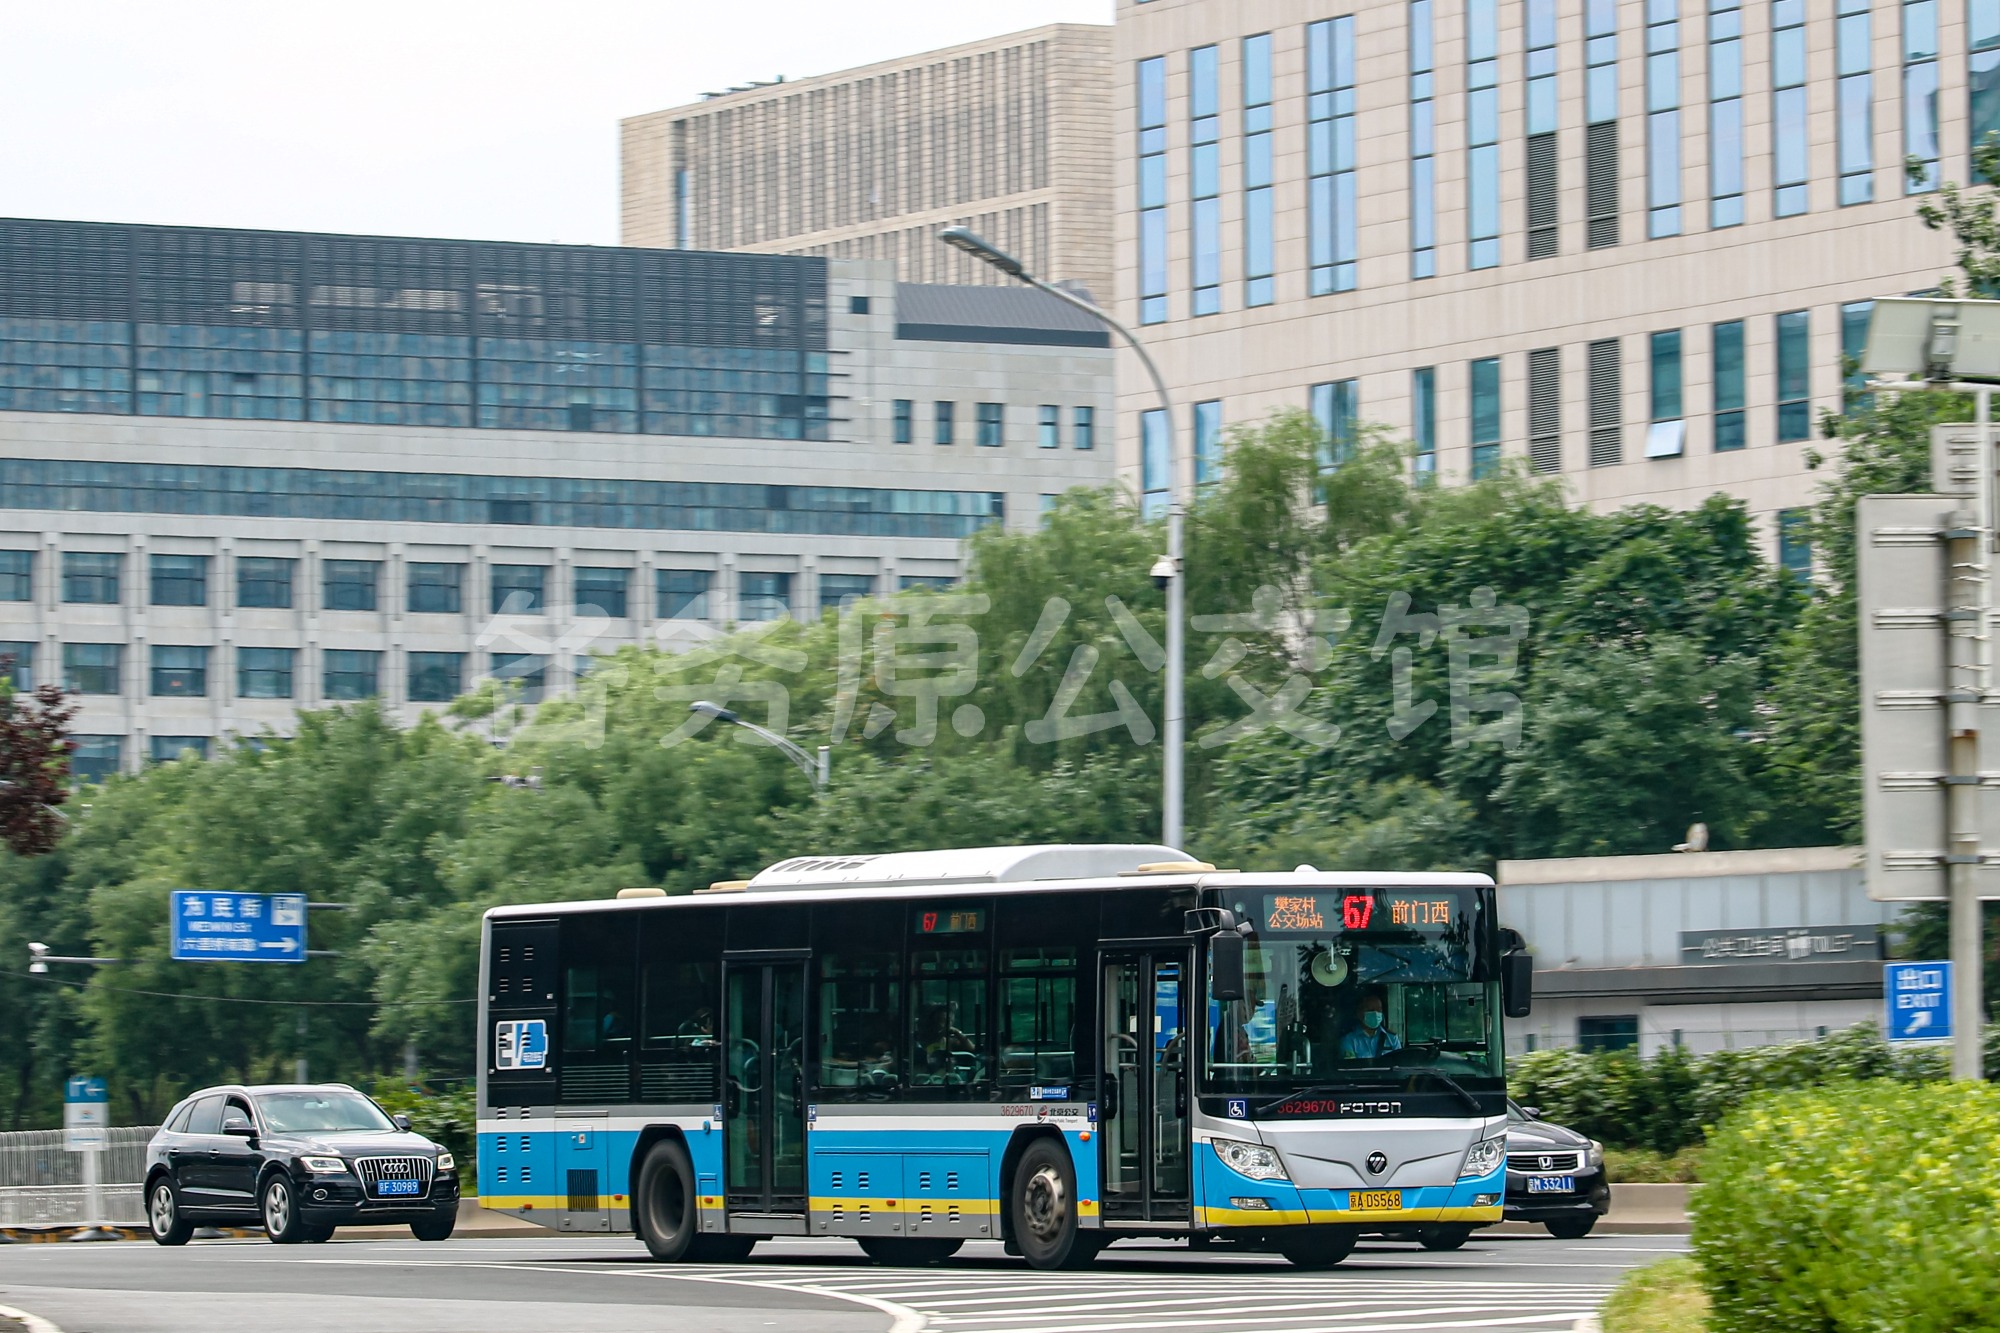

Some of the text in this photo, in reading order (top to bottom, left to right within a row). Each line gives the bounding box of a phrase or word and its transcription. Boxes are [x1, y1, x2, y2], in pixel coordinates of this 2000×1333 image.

[1274, 896, 1316, 913] 樊家村
[1343, 896, 1374, 929] 67
[1391, 900, 1450, 924] 前门西
[923, 912, 938, 932] 67
[1268, 912, 1324, 929] 公交场站
[1896, 968, 1943, 990] 出口
[1896, 993, 1943, 1009] EXIT
[1001, 1105, 1034, 1116] 3629670
[1340, 1102, 1402, 1114] FOTON
